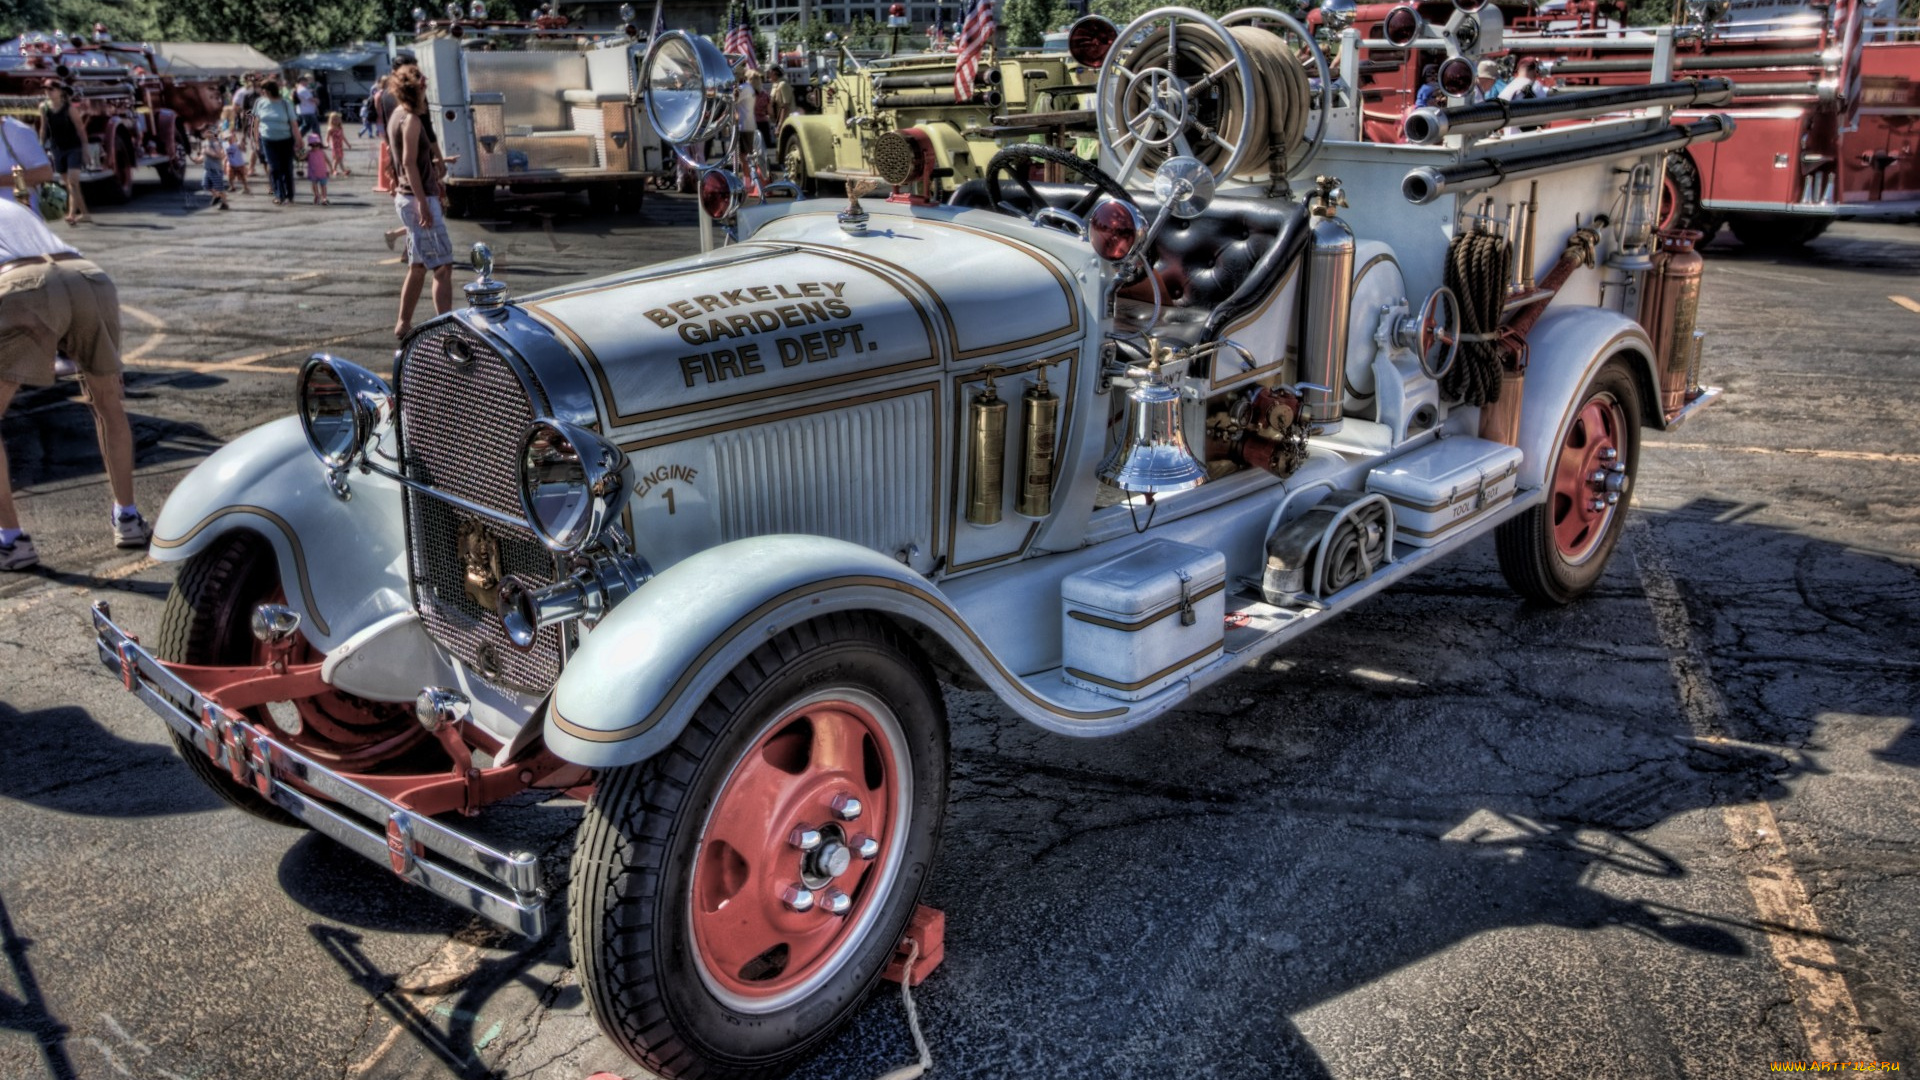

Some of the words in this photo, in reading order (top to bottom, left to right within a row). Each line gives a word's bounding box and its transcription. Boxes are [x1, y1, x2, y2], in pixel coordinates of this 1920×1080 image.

[643, 281, 846, 329] BERKELEY
[677, 298, 851, 346] GARDENS
[678, 343, 765, 388] FIRE
[775, 324, 878, 368] DEPT.
[633, 464, 698, 499] ENGINE
[661, 487, 676, 515] 1
[1452, 501, 1470, 518] TOOL
